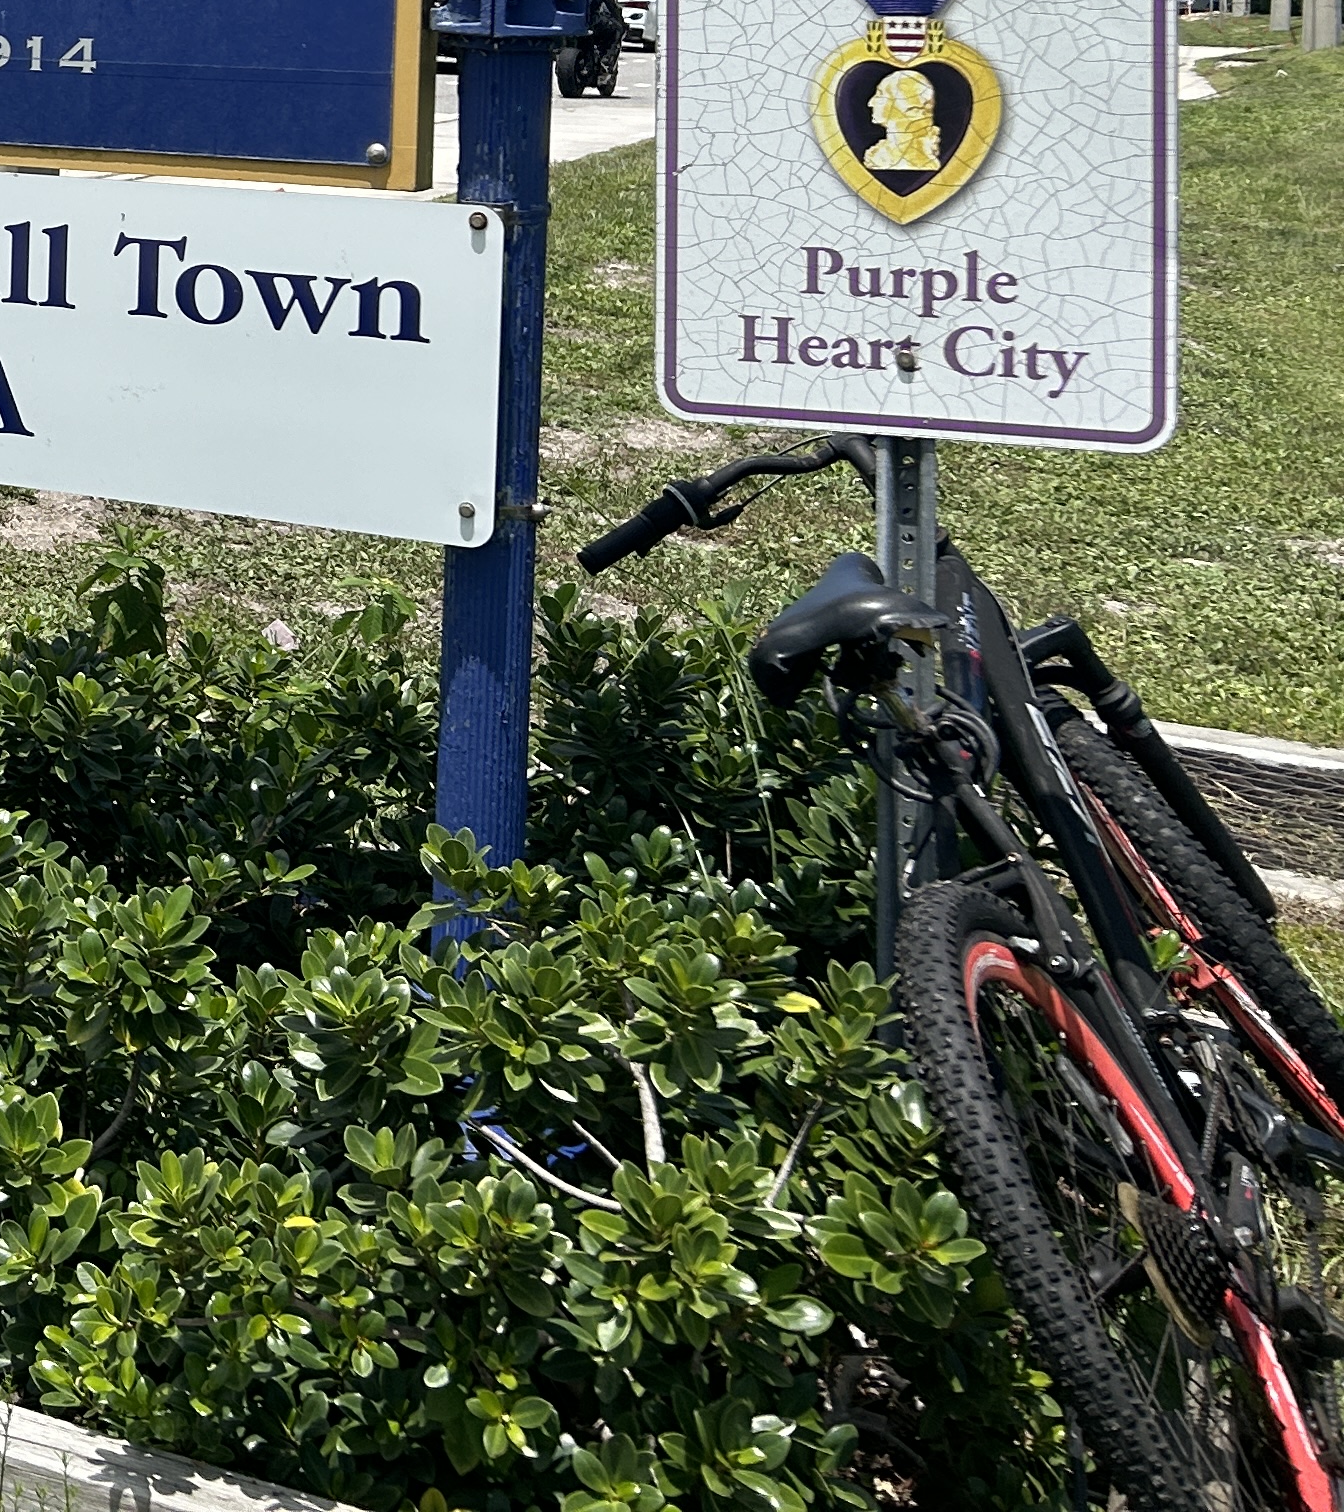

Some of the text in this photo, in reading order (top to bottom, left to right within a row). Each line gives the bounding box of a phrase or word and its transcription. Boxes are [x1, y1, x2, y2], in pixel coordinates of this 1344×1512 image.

[114, 231, 430, 344] Town
[799, 246, 1020, 318] Purple
[738, 314, 1090, 399] Heart City
